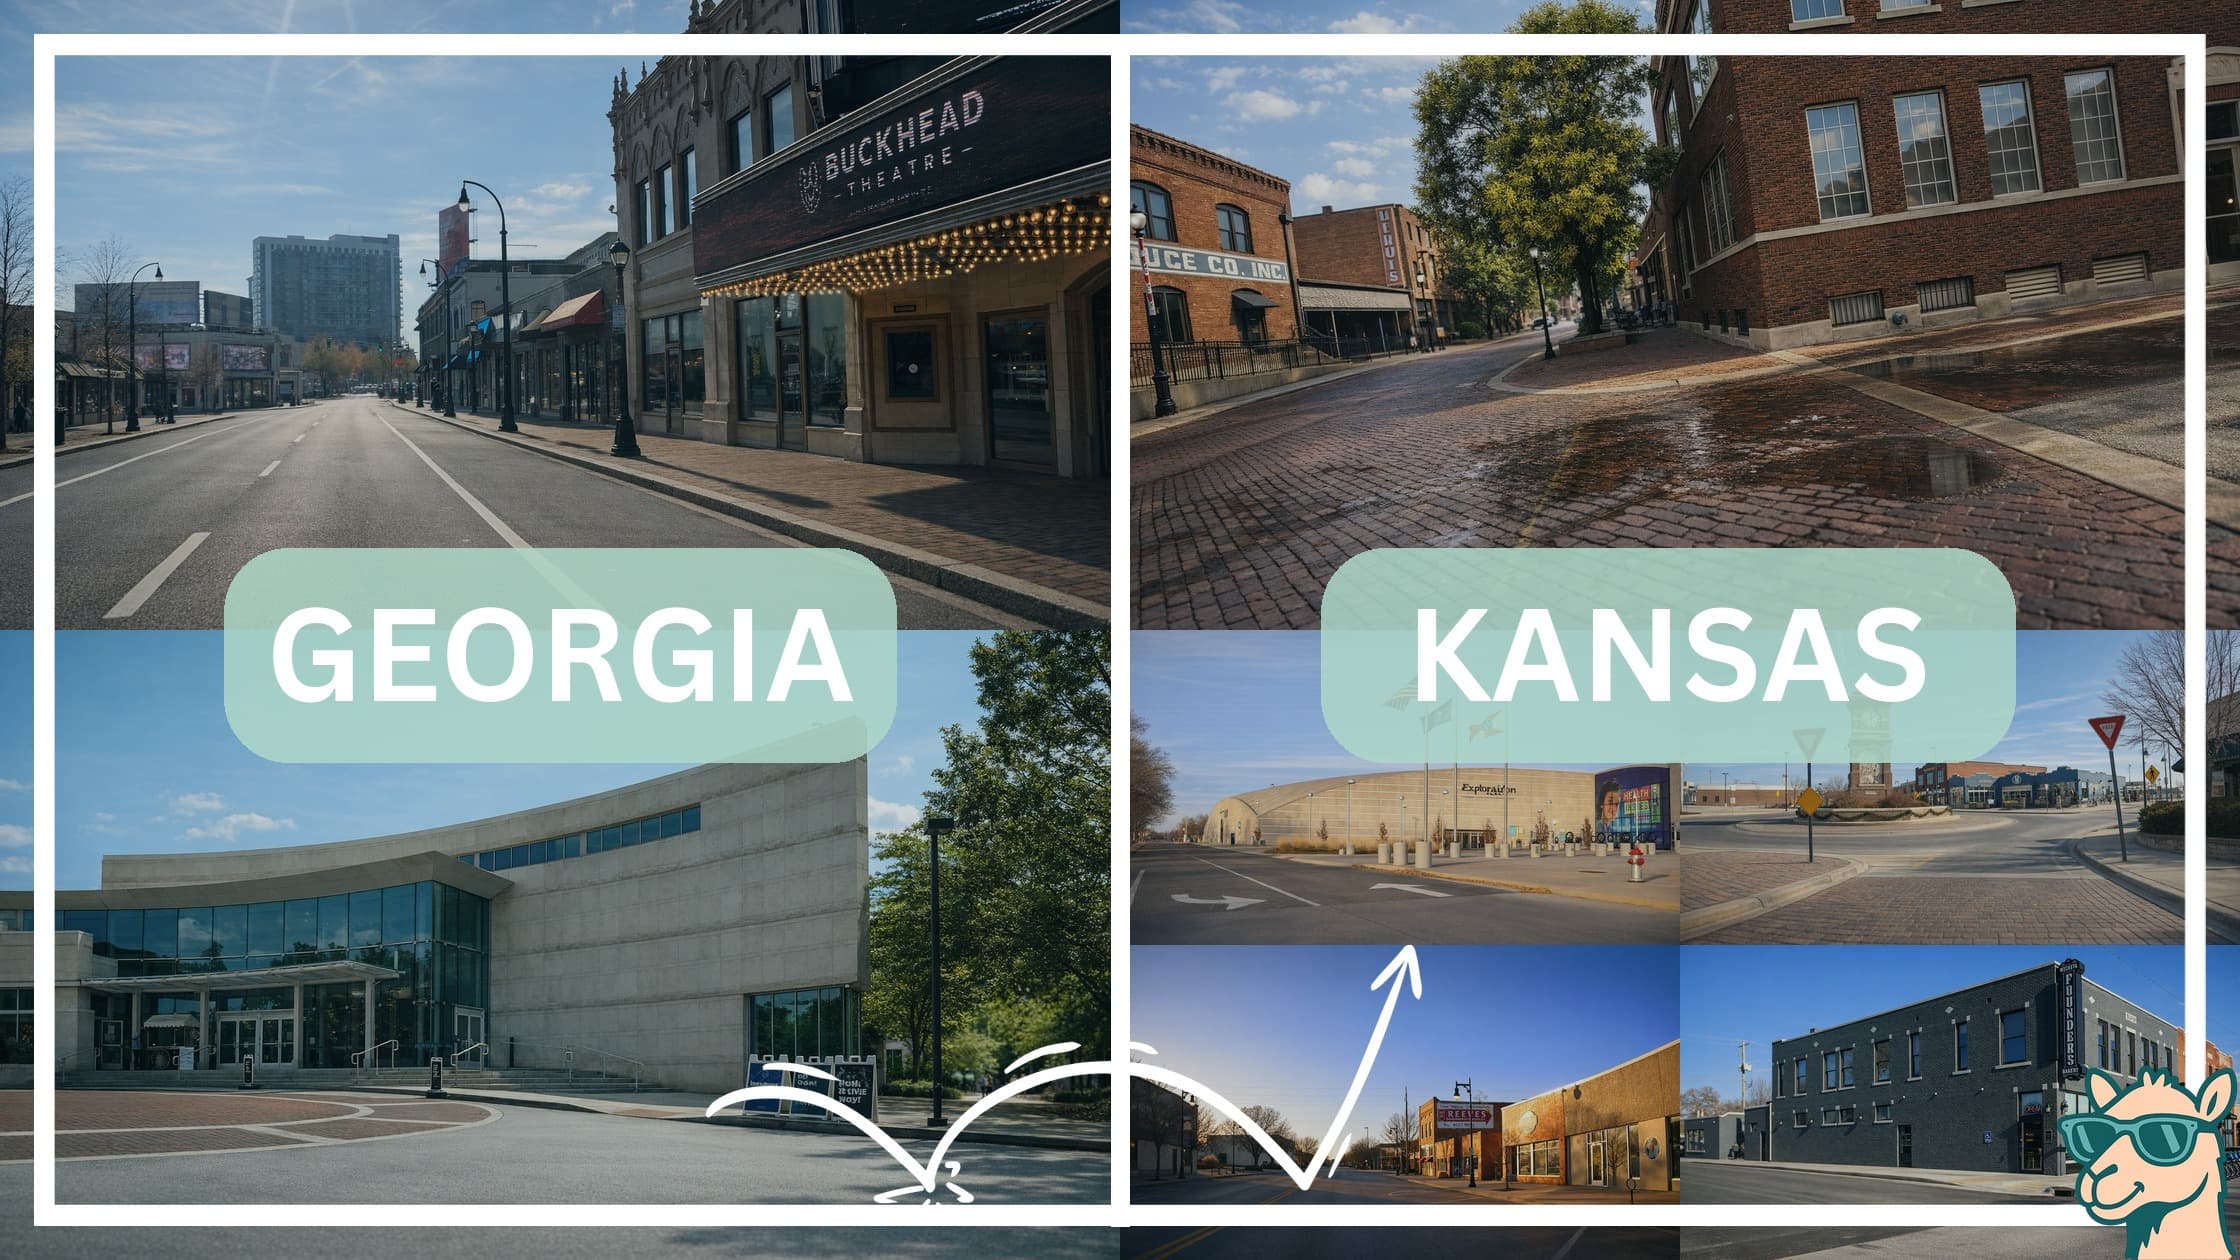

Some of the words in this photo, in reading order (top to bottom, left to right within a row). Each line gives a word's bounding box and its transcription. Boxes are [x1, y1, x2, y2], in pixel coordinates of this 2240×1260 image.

[825, 90, 984, 181] BUCKHEAD
[847, 146, 952, 197] THEATRE
[1207, 255, 1245, 276] CO.
[1251, 261, 1286, 281] INC.
[1623, 789, 1649, 801] HELTH
[2065, 973, 2074, 1066] FOUNDERS
[1447, 1110, 1487, 1119] REEVES
